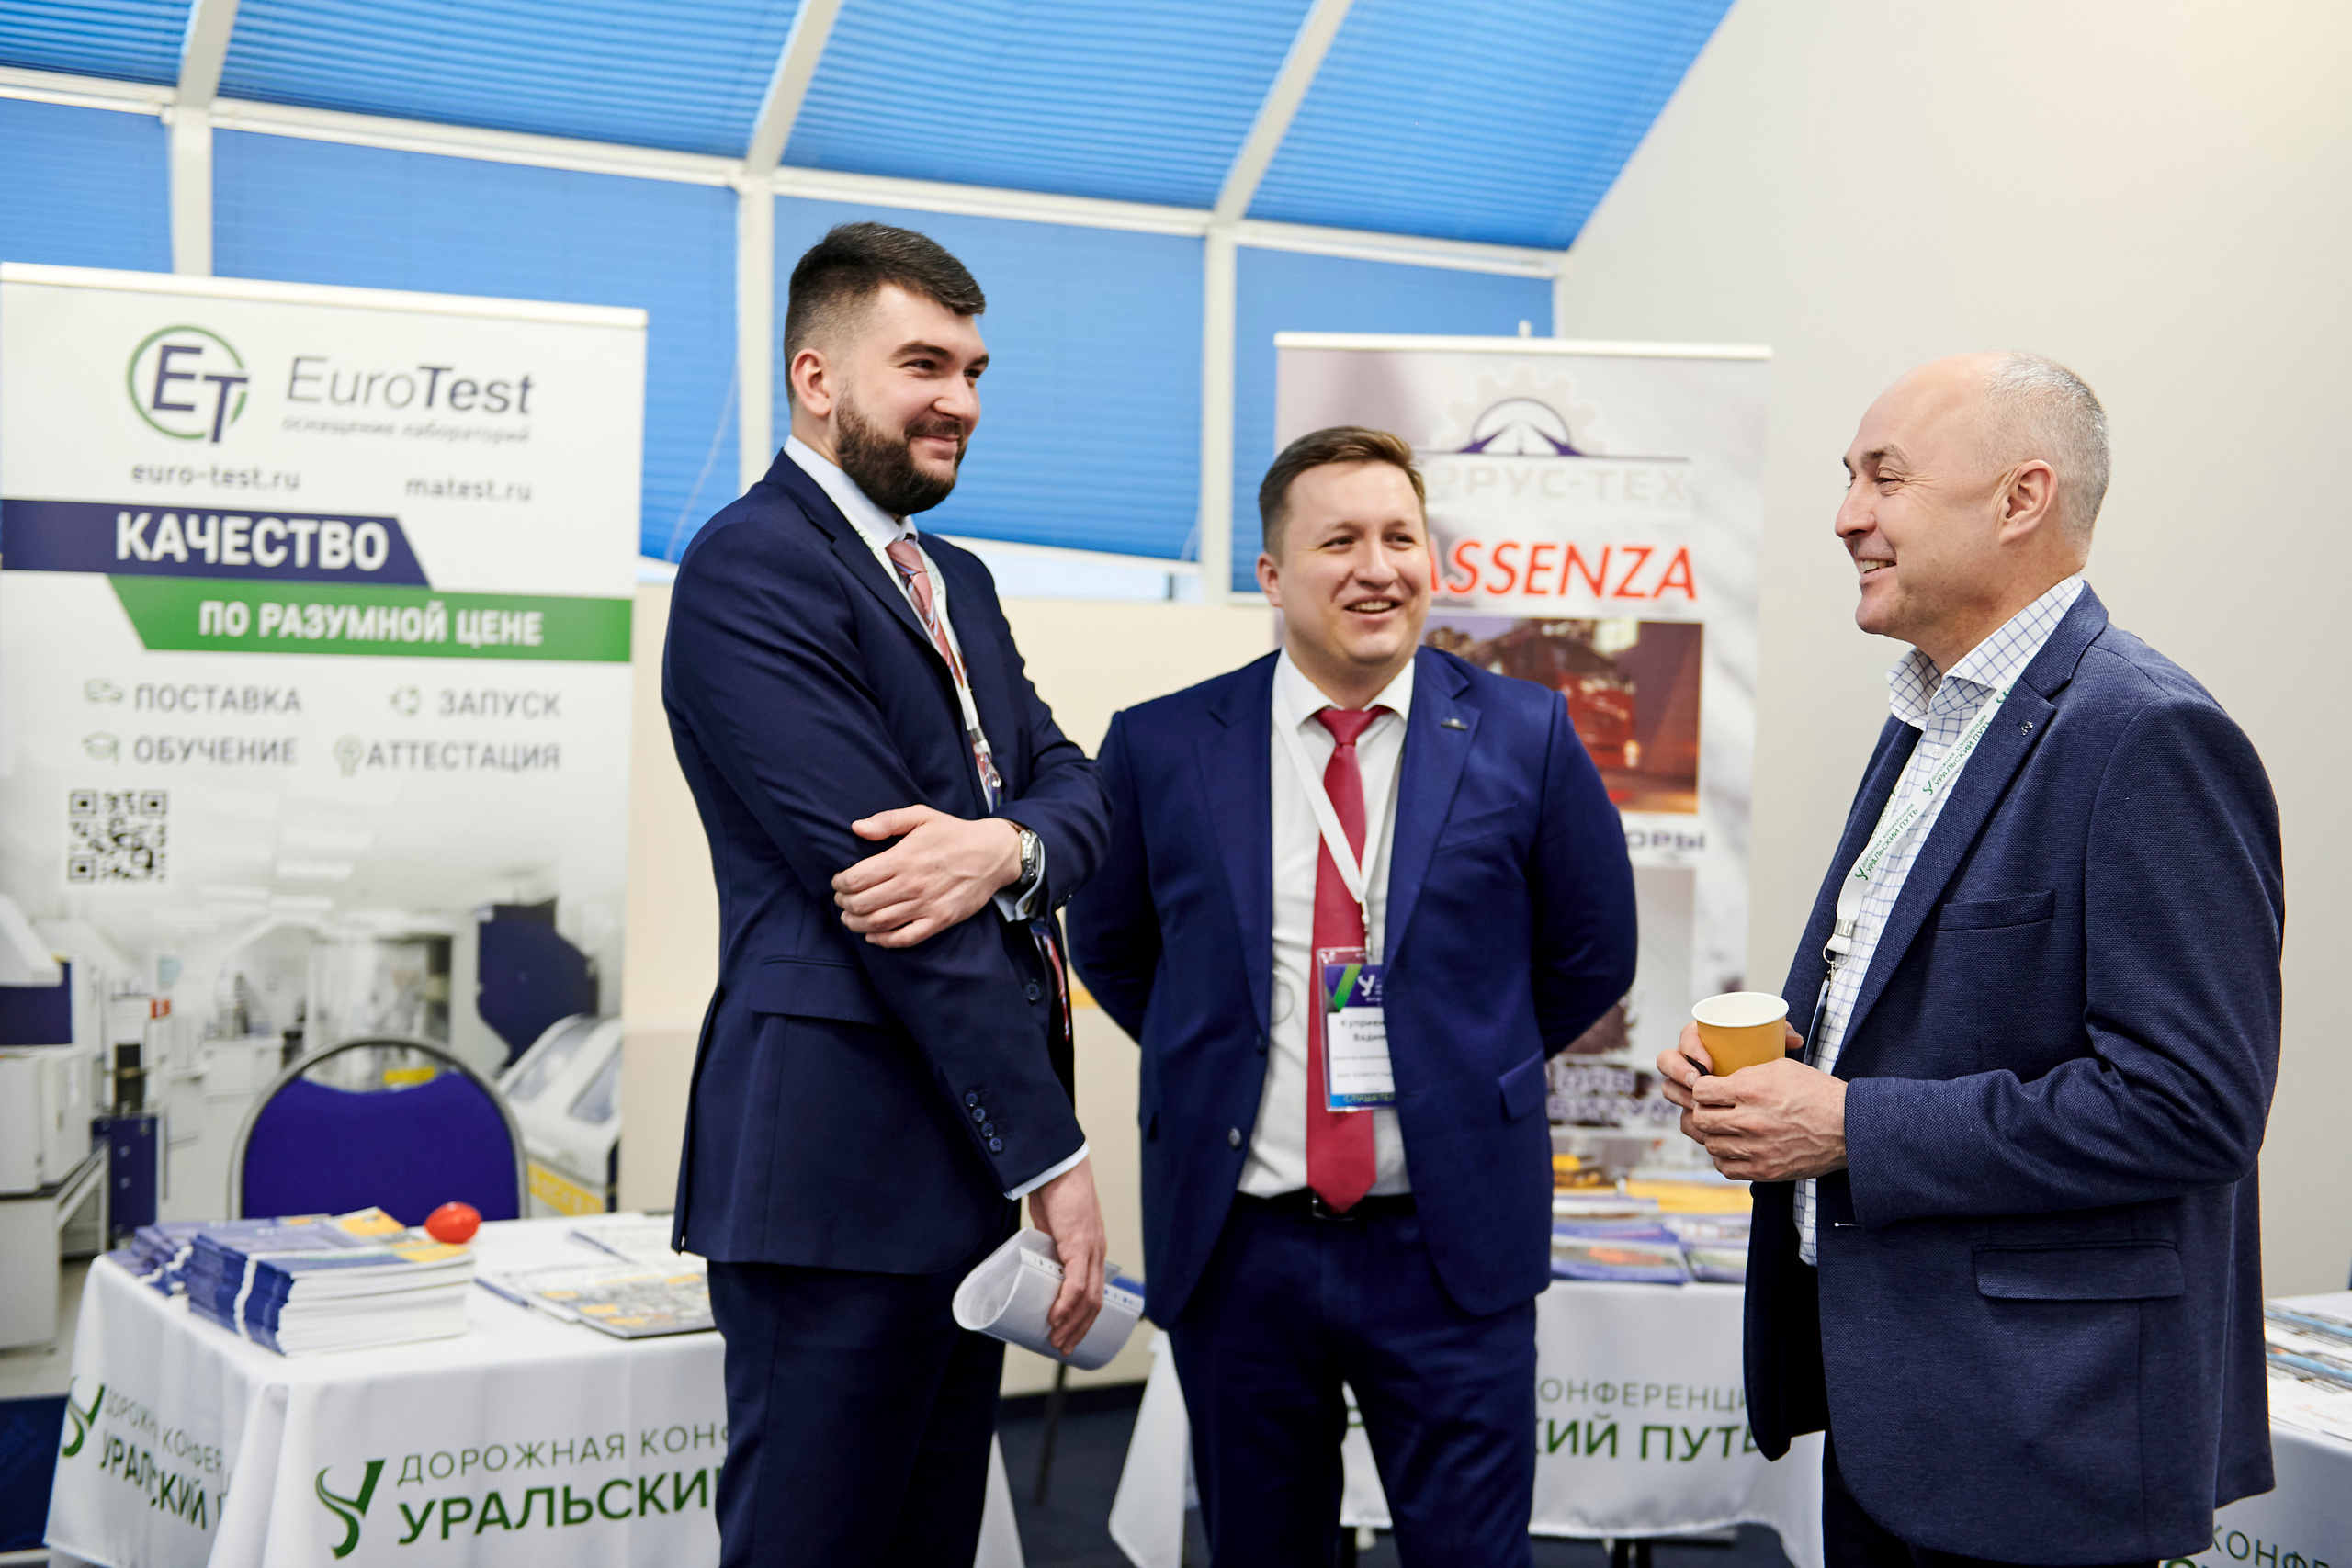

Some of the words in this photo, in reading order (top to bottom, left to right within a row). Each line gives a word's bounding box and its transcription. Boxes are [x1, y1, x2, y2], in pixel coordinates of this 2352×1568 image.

[287, 356, 537, 414] EuroTest
[401, 420, 531, 446] лабораторий
[132, 463, 300, 491] euro-test.ru
[405, 476, 532, 503] matest.ru
[116, 512, 390, 572] КАЧЕСТВО
[199, 601, 250, 638] ПО
[258, 602, 447, 646] РАЗУМНОЙ
[458, 610, 544, 649] ЦЕНЕ
[135, 684, 302, 714] ПОСТАВКА
[438, 689, 561, 719] ЗАПУСК
[134, 737, 299, 766] ОБУЧЕНИЕ
[367, 740, 561, 773] АТТЕСТАЦИЯ
[1934, 740, 1975, 786] УРАЛЬСКИЙ
[1624, 829, 1706, 852] ОРЫ
[1866, 829, 1900, 874] УРАЛЬСКИЙ
[1899, 808, 1919, 829] ПУТЬ
[397, 1433, 626, 1487] ДОРОЖНАЯ
[397, 1462, 724, 1545] УРАЛЬСКИ
